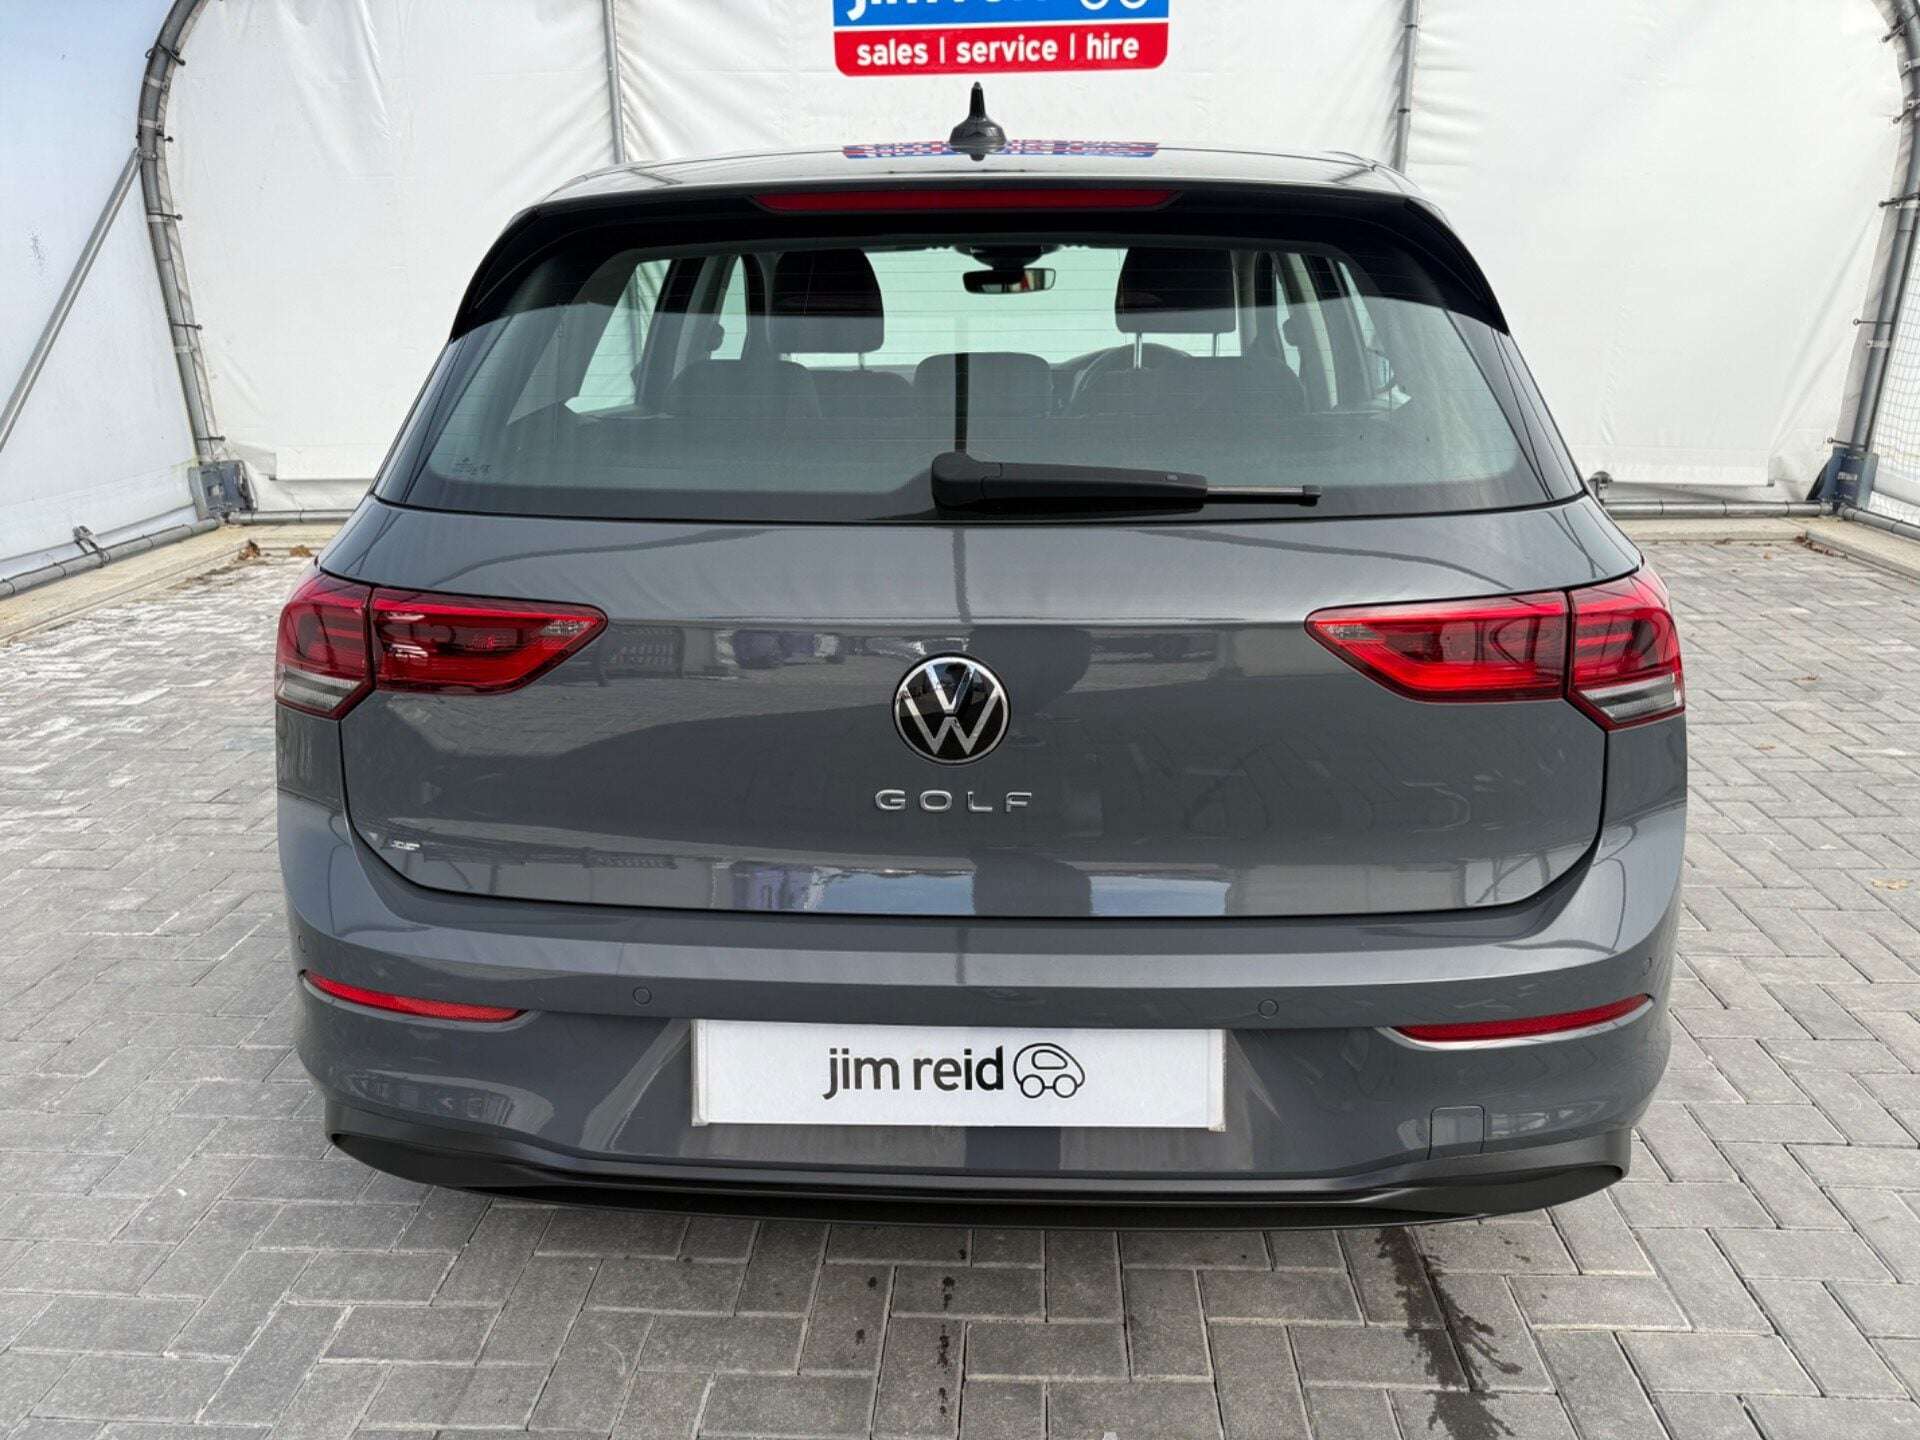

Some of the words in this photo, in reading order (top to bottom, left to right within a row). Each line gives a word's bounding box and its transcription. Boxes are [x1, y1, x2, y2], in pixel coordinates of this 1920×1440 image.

[856, 38, 929, 66] sales
[955, 34, 1058, 64] service
[1086, 32, 1140, 60] hire
[874, 788, 1033, 813] GOLF
[822, 1047, 901, 1100] jim
[913, 1045, 1004, 1091] reid
